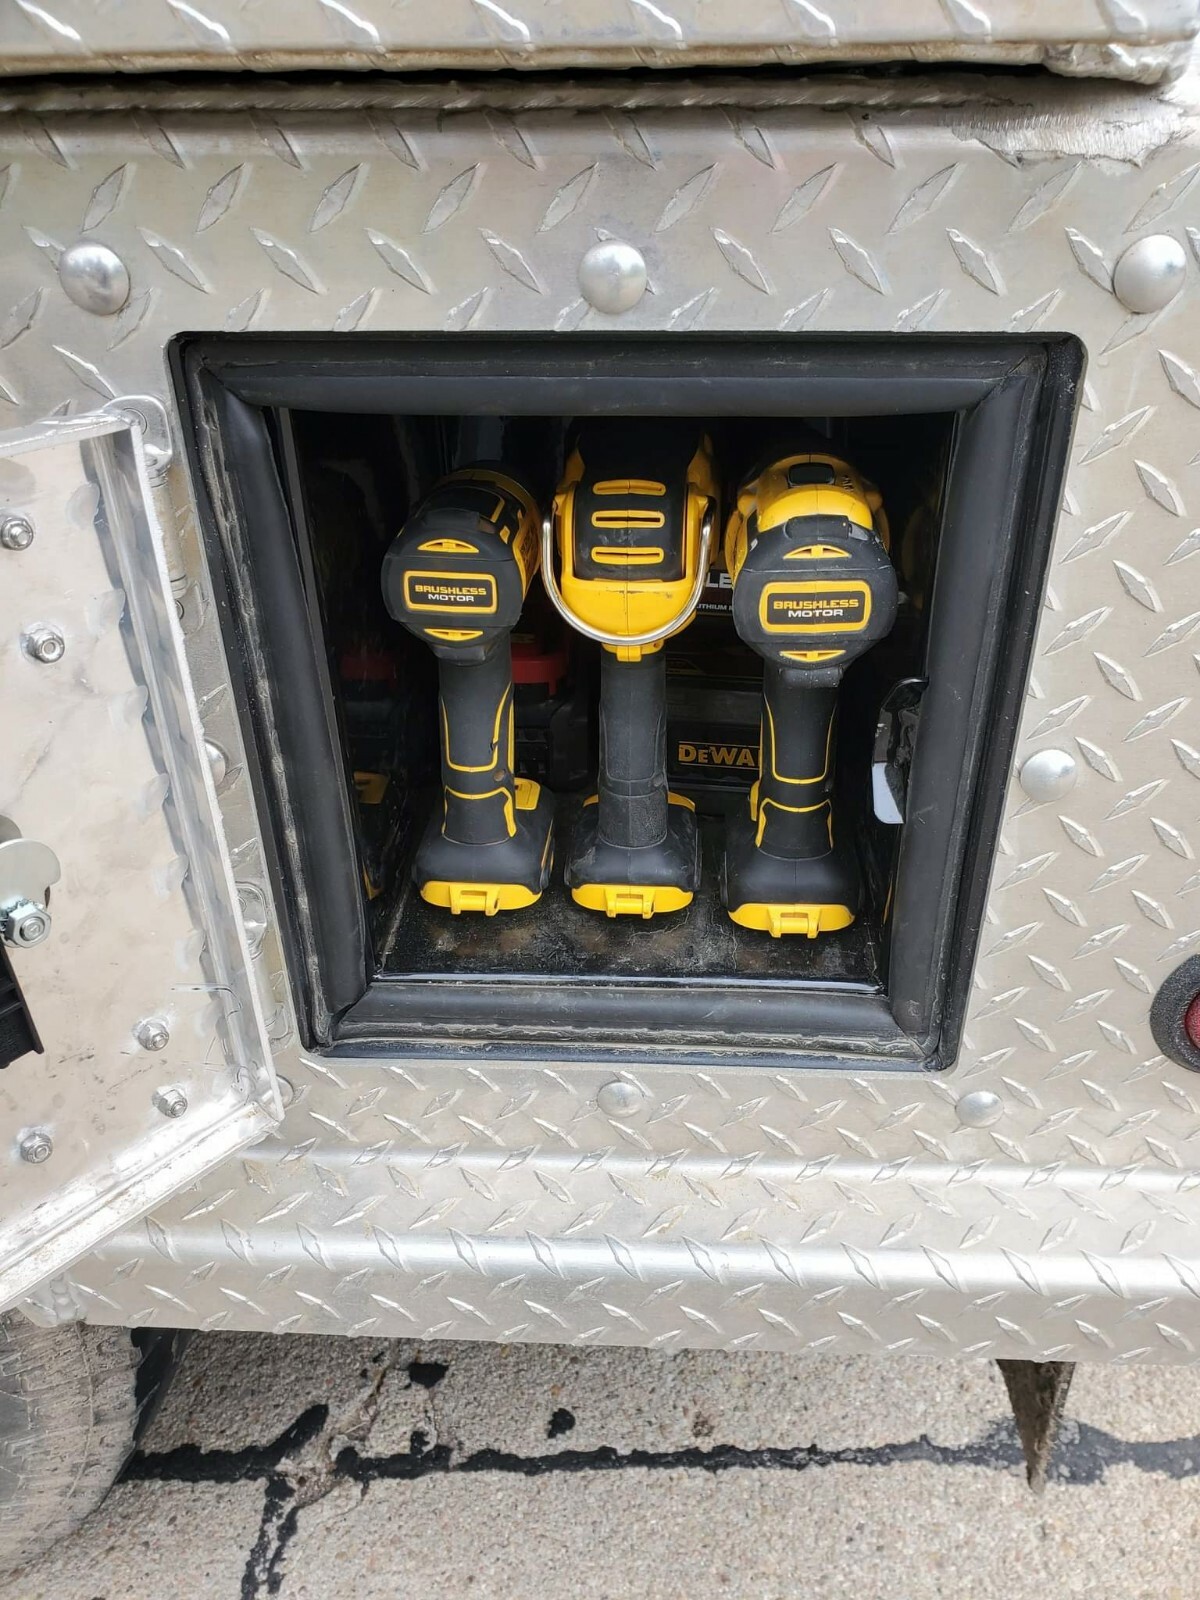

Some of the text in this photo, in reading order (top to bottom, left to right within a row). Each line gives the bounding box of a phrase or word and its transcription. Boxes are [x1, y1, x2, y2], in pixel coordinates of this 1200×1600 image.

[415, 585, 487, 595] BRUSHLESS
[428, 594, 474, 602] MOTOR
[773, 599, 859, 610] BRUSHLESS
[788, 609, 844, 618] MOTOR
